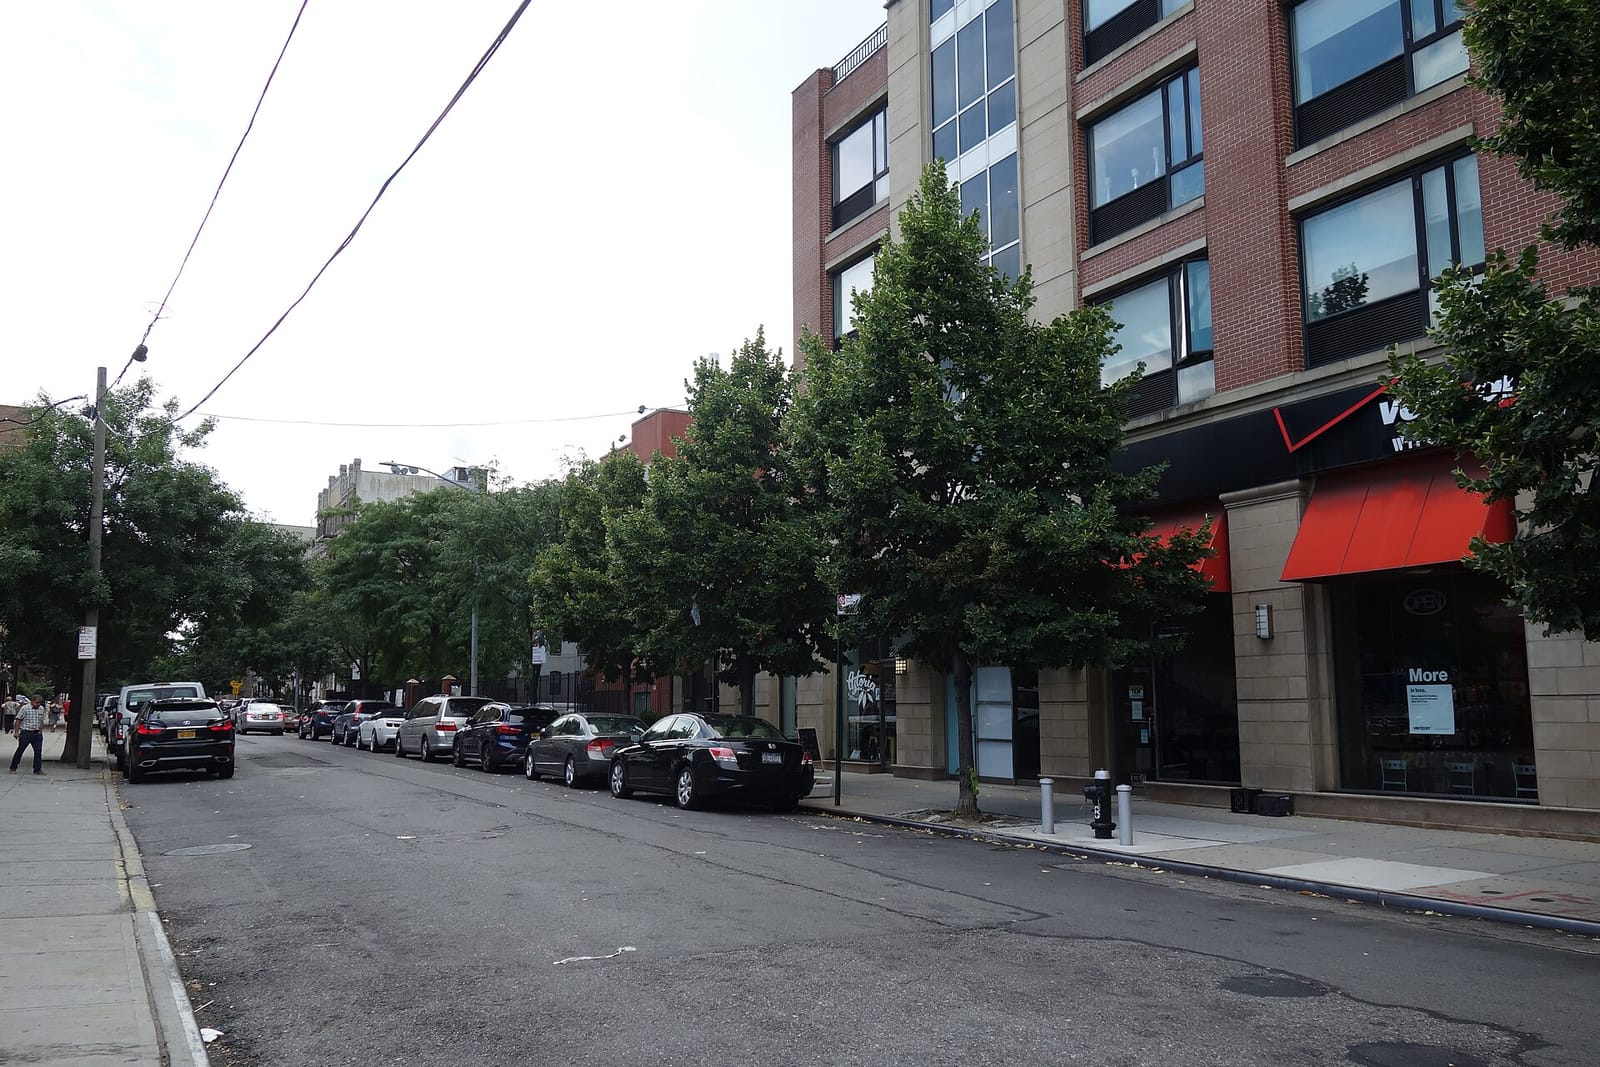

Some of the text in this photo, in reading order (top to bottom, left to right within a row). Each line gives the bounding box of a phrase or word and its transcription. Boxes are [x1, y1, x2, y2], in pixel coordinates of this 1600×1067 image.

[1404, 594, 1442, 609] OPEN
[846, 669, 876, 695] Astoria
[1409, 668, 1449, 682] More
